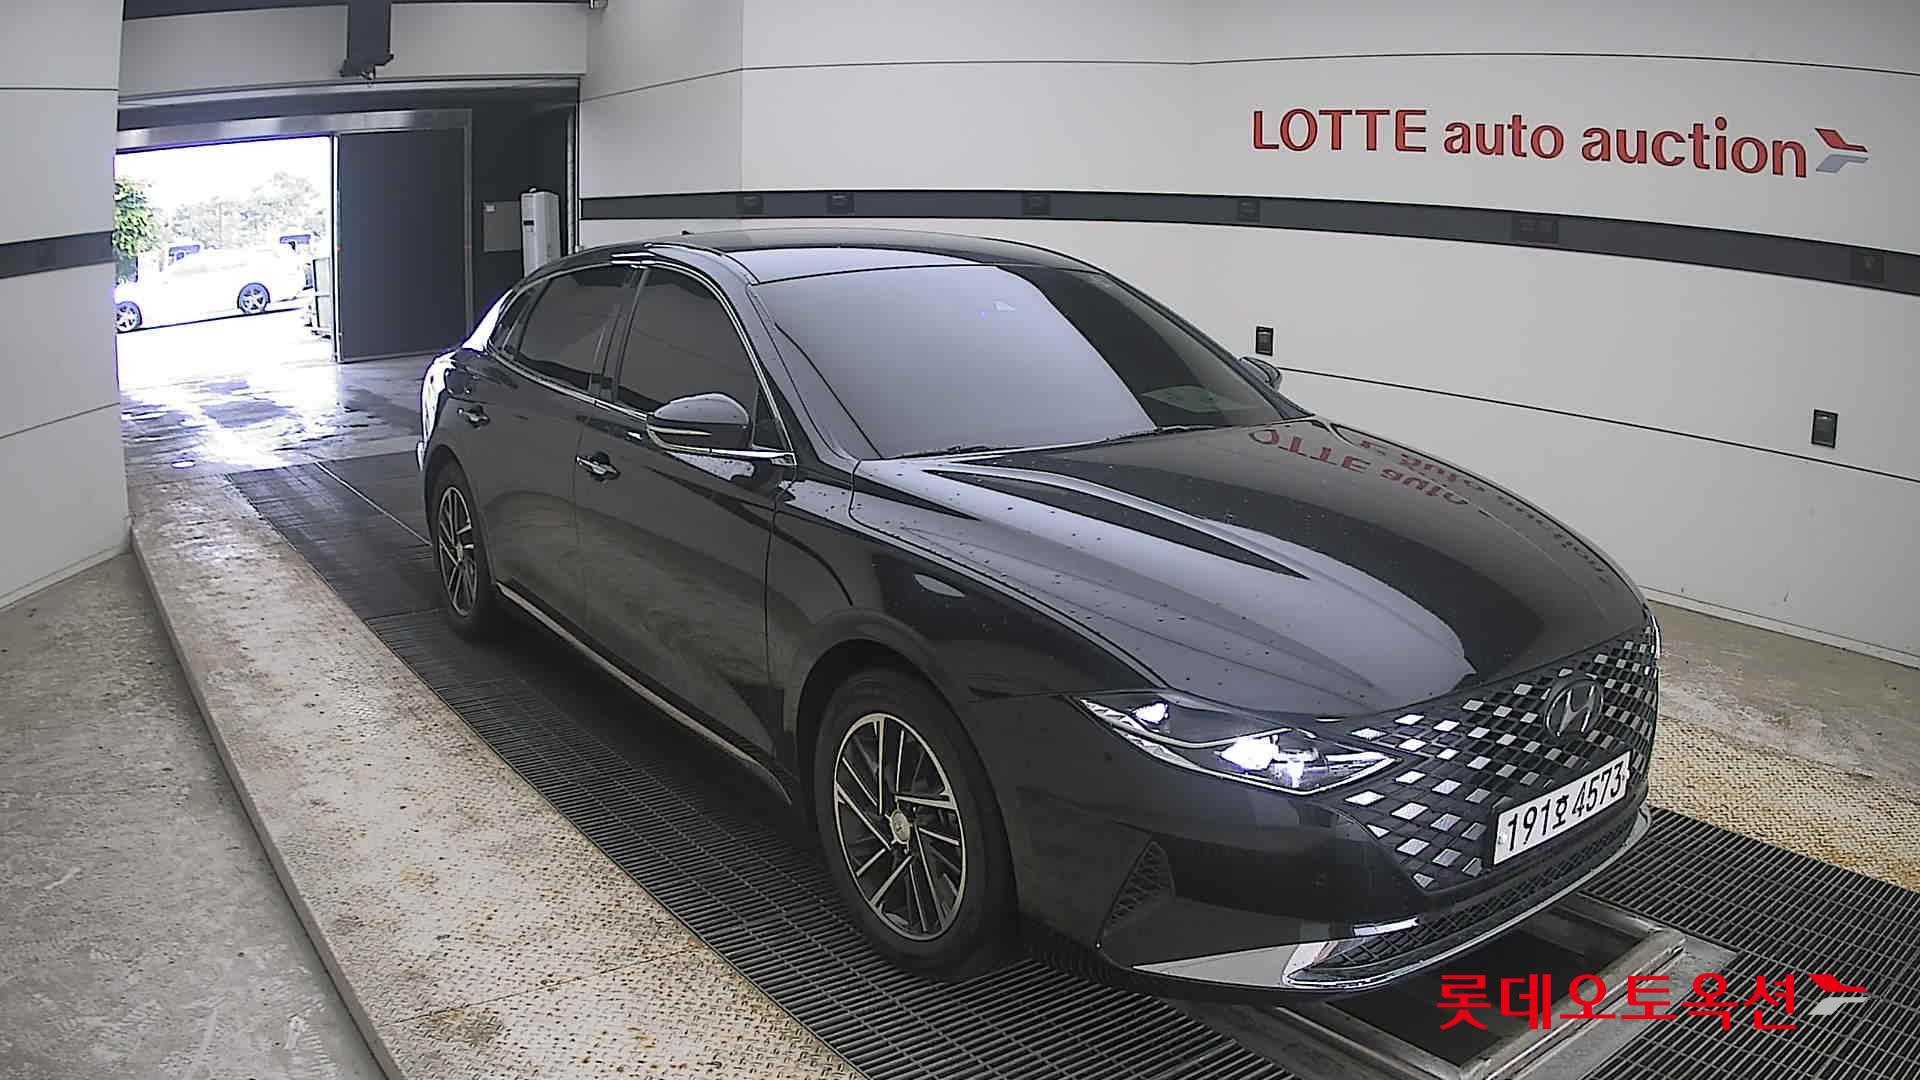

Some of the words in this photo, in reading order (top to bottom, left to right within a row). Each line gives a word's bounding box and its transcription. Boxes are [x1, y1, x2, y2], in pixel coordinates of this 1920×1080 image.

[1253, 109, 1427, 152] LOTTE
[1443, 115, 1565, 159] auto
[1581, 117, 1808, 178] auction
